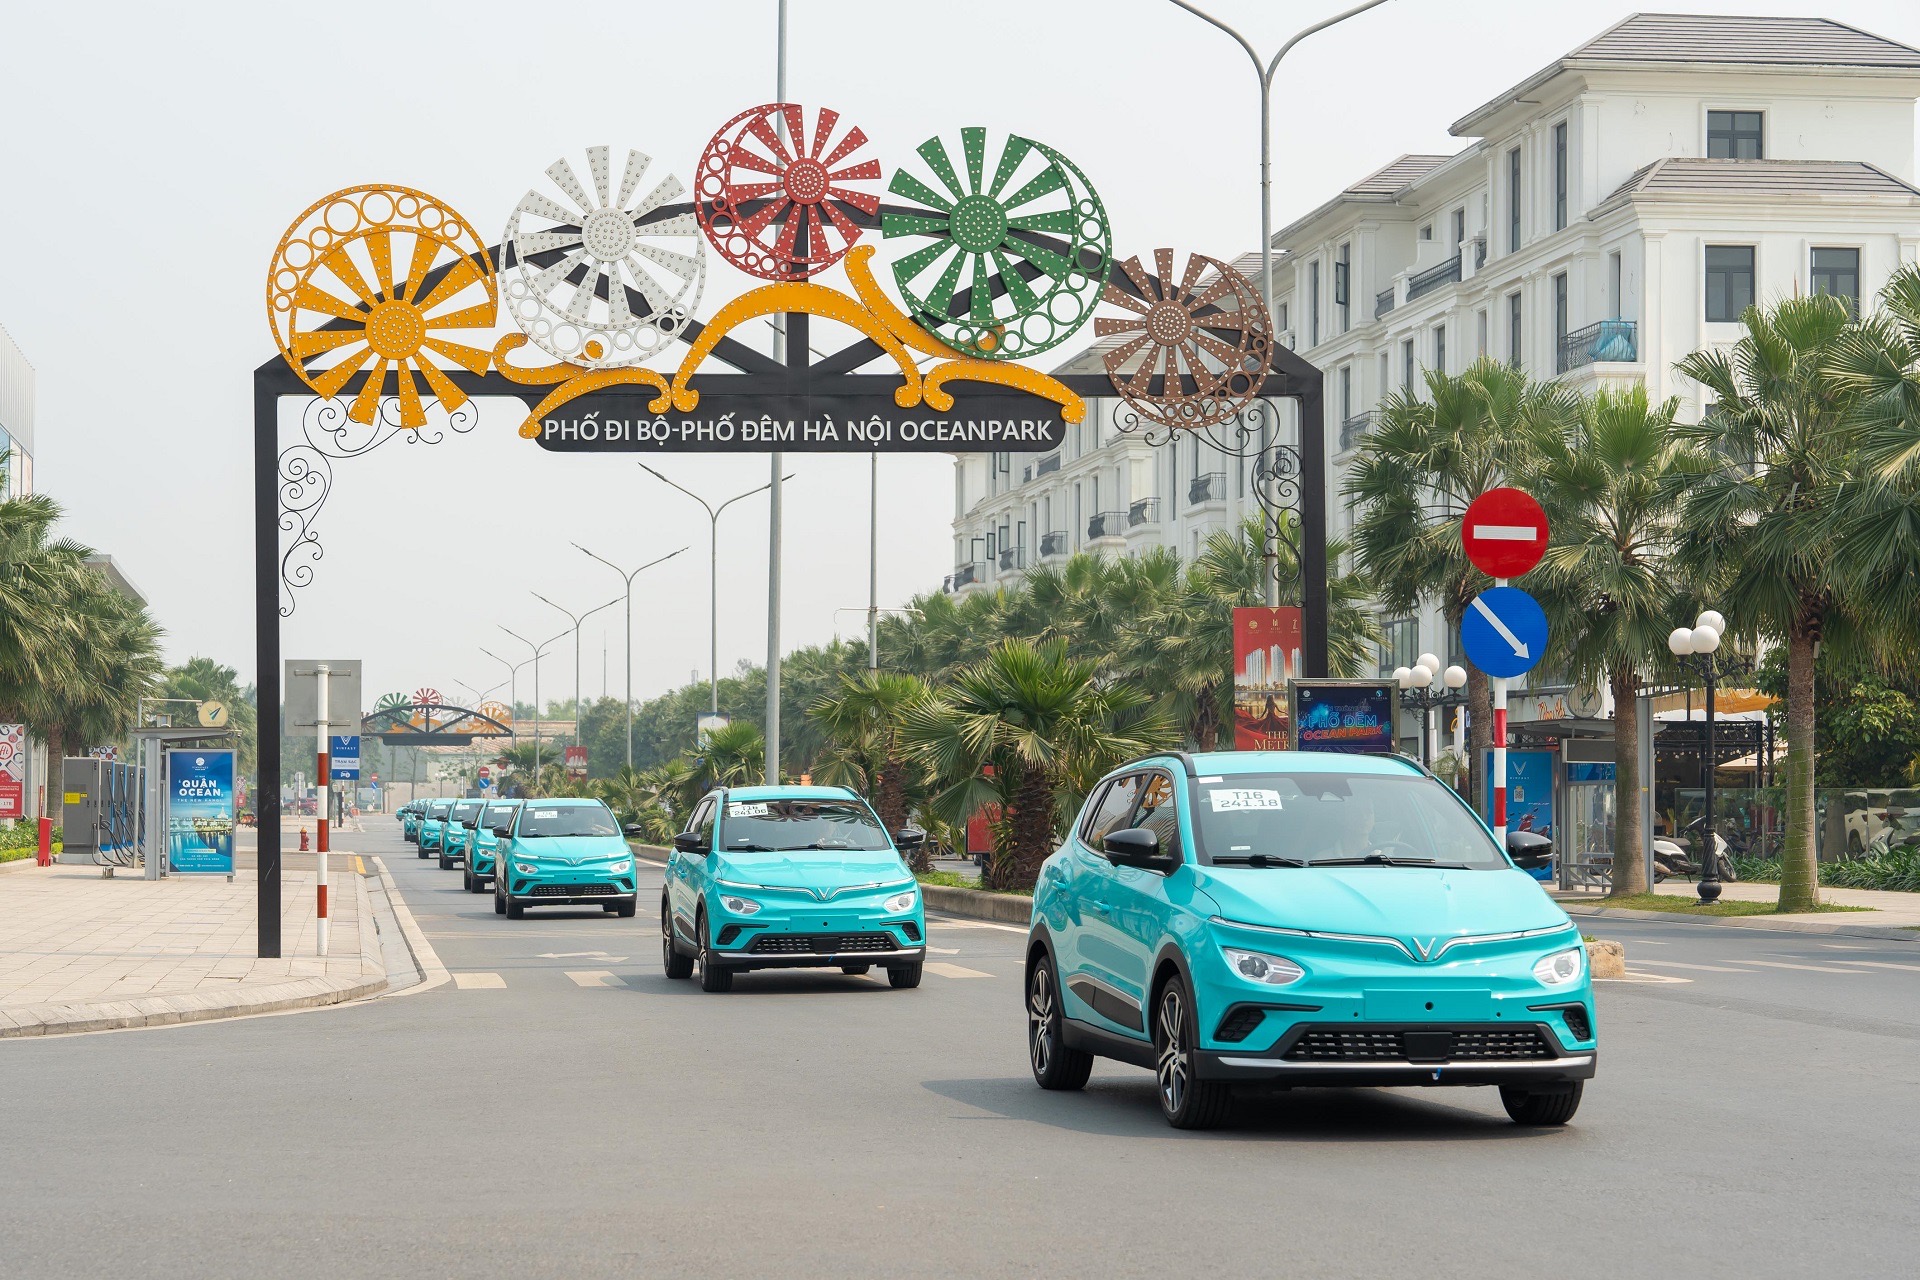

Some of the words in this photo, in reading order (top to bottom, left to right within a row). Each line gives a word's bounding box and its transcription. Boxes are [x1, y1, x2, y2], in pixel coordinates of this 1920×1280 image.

[544, 411, 600, 441] PHỐ
[604, 419, 630, 441] ĐI
[740, 414, 795, 442] ĐÊM
[803, 413, 839, 442] HÀ
[847, 414, 892, 447] NỘI
[899, 419, 1053, 442] OCEANPARK
[1308, 711, 1340, 728] PHỐ
[1343, 710, 1377, 728] ĐÊM
[1265, 731, 1288, 739] THE
[1303, 728, 1347, 741] OCEAN
[1349, 725, 1384, 737] PARK
[1232, 791, 1264, 800] T16
[1220, 799, 1279, 808] 241.18
